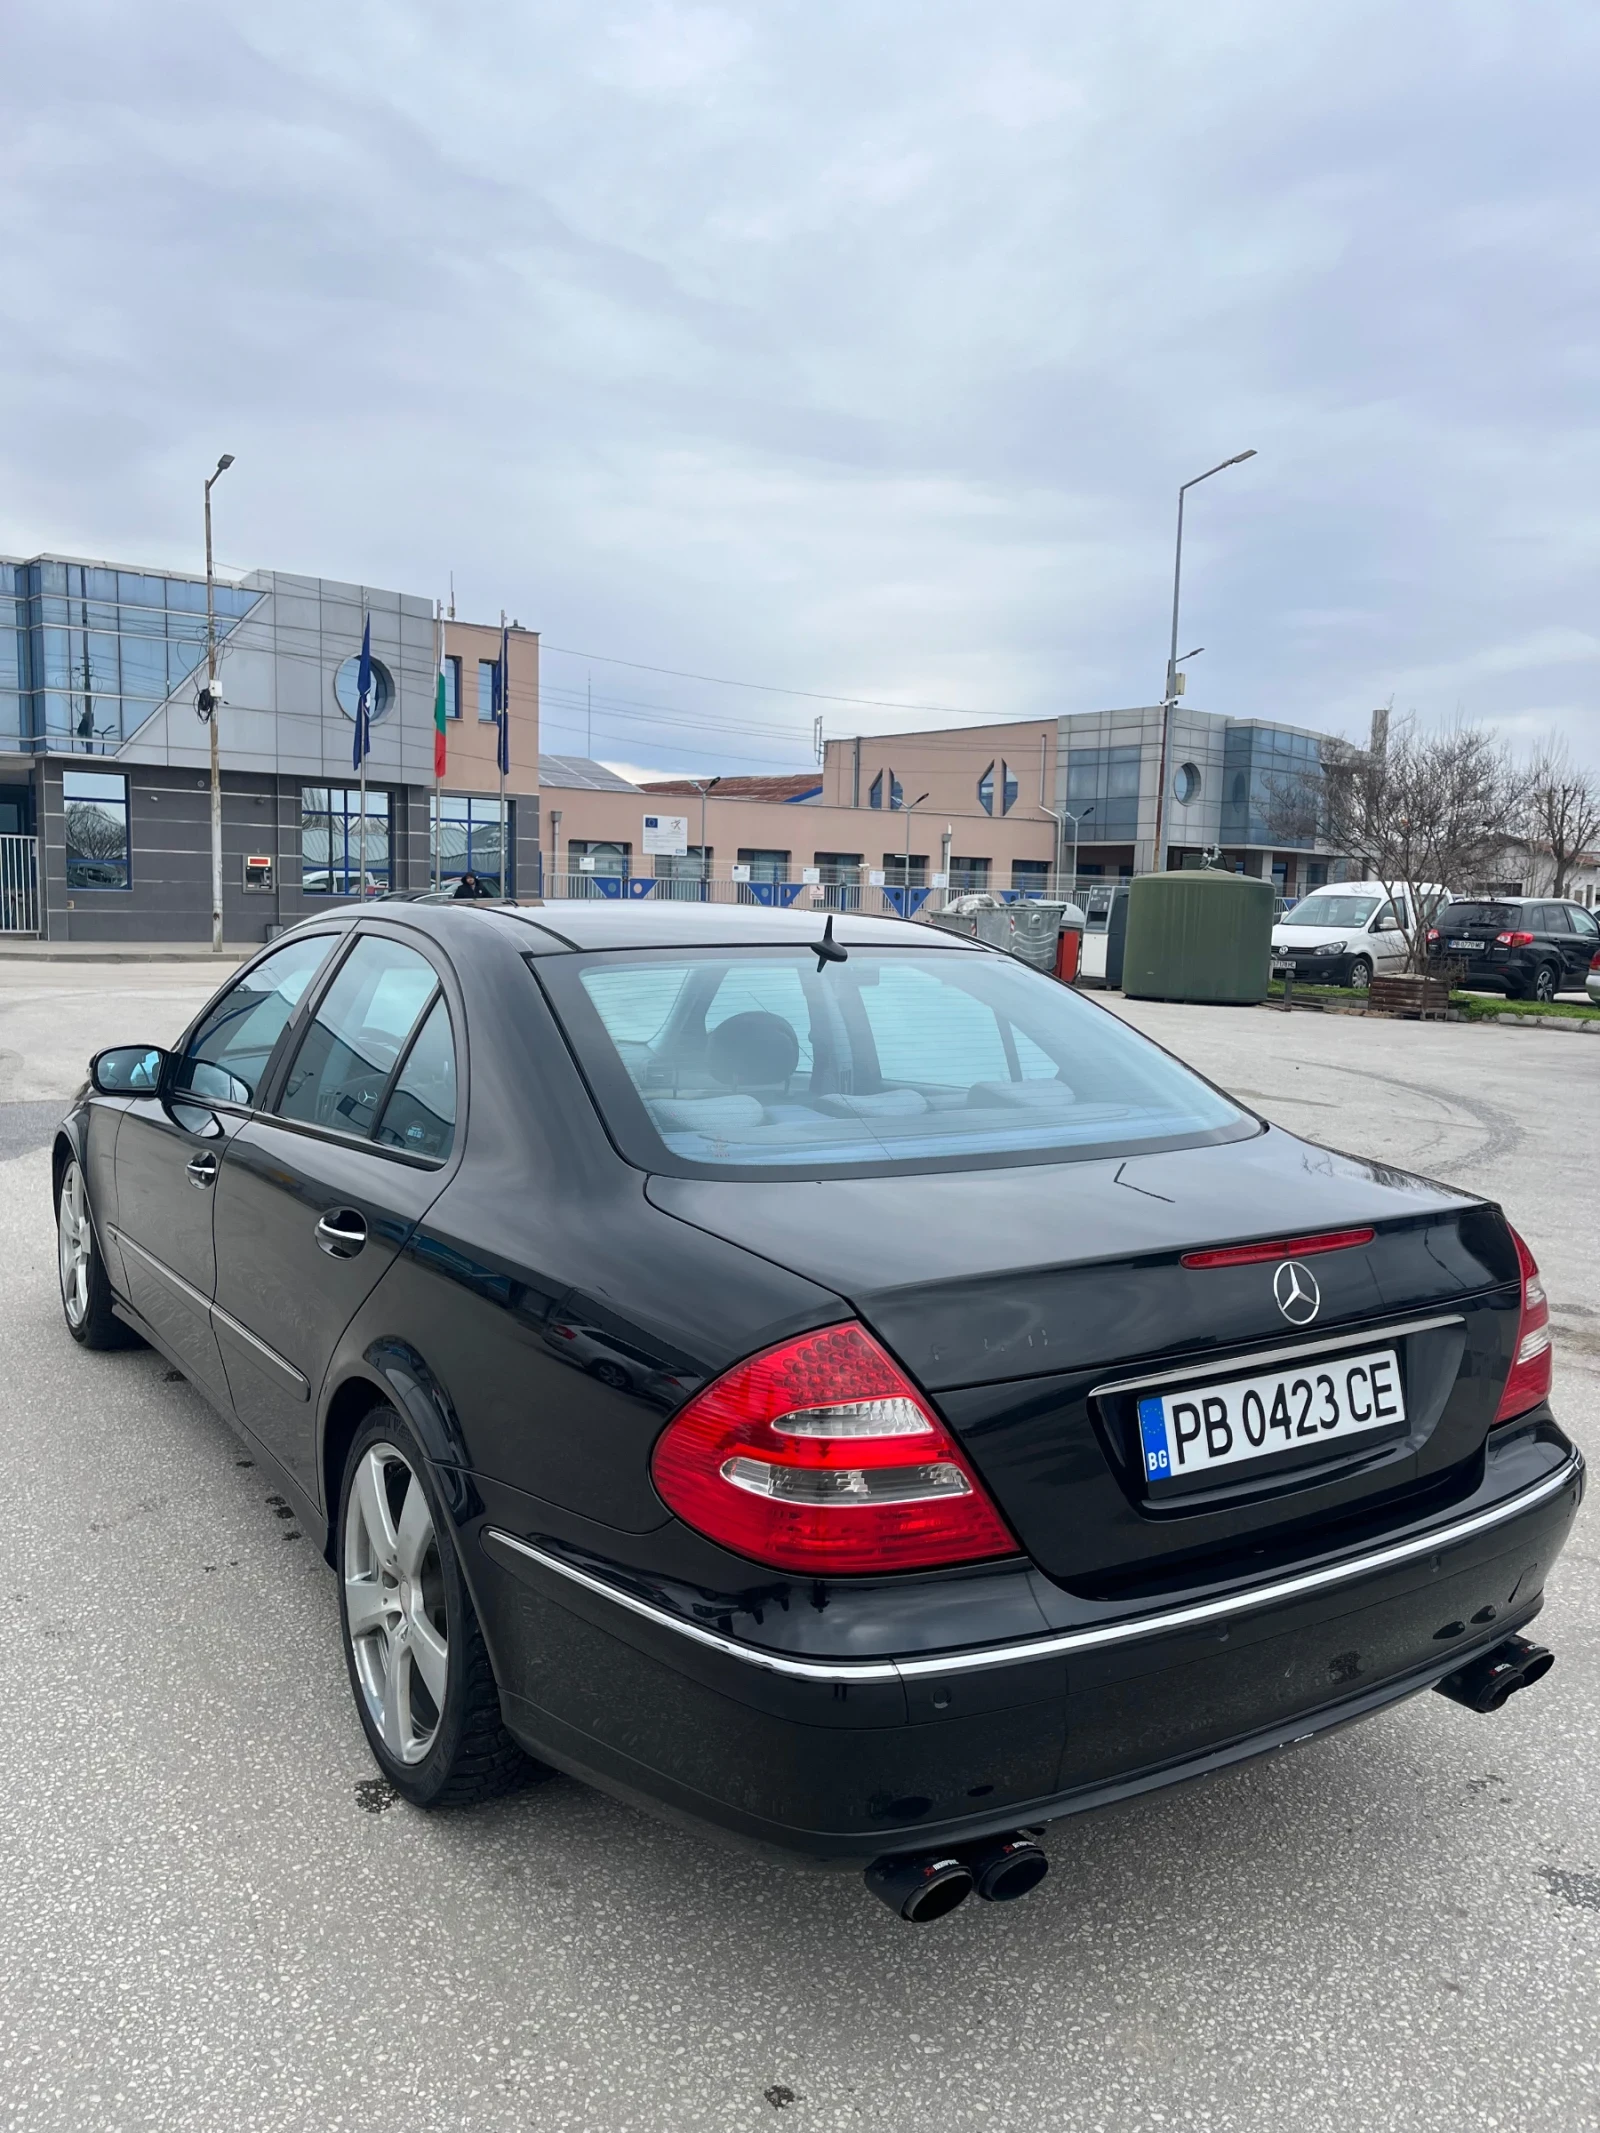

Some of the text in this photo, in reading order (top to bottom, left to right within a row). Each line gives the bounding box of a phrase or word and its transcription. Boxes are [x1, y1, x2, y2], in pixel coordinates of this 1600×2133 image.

[1172, 1361, 1397, 1465] PB 0423 CE
[1148, 1449, 1168, 1471] BG
